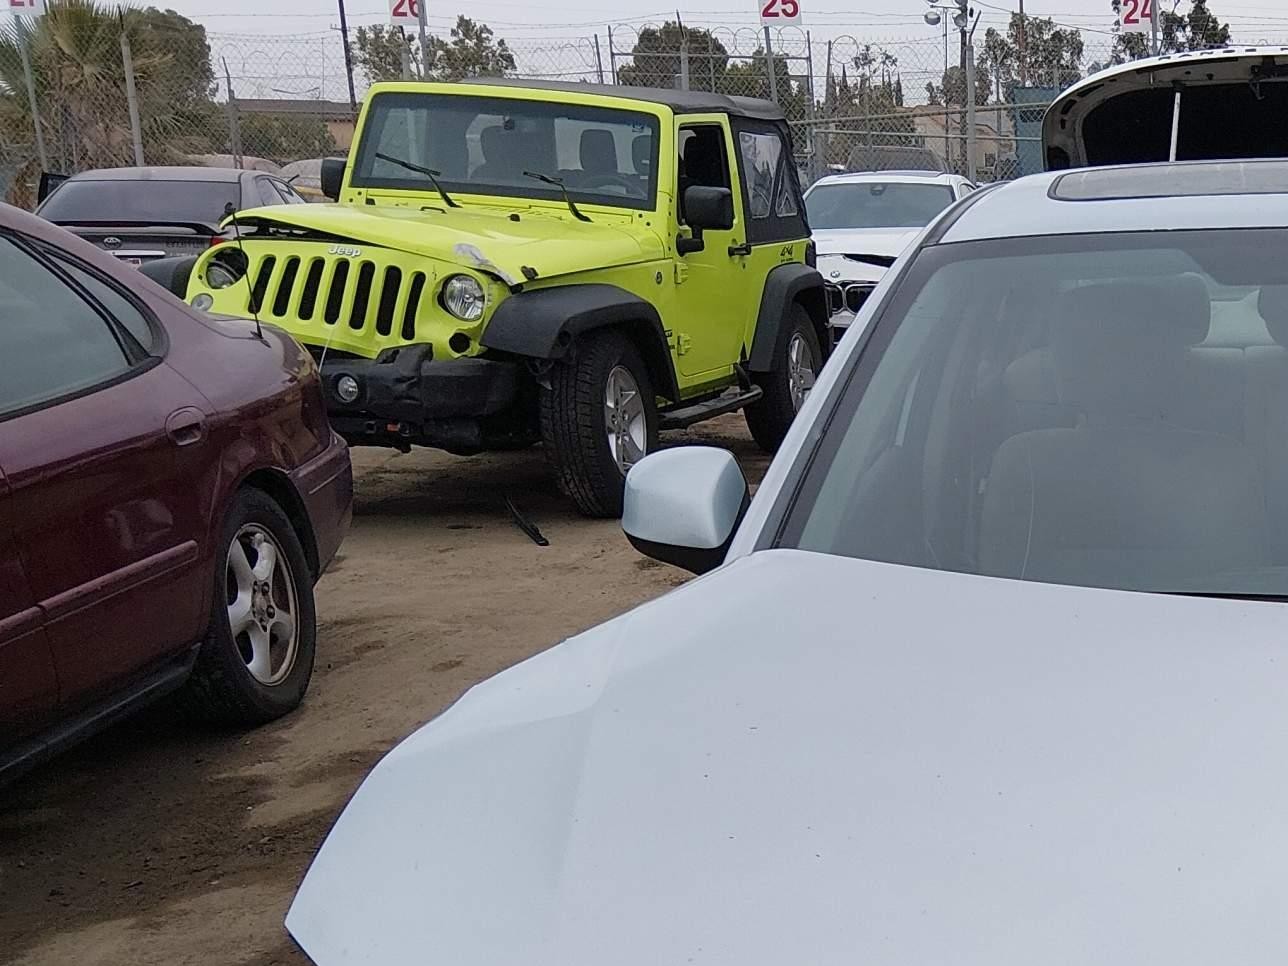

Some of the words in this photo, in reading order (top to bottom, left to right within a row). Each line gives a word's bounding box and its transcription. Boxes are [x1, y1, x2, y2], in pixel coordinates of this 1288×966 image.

[762, 0, 799, 18] 25
[1123, 0, 1153, 24] 24
[328, 245, 361, 258] Jeep
